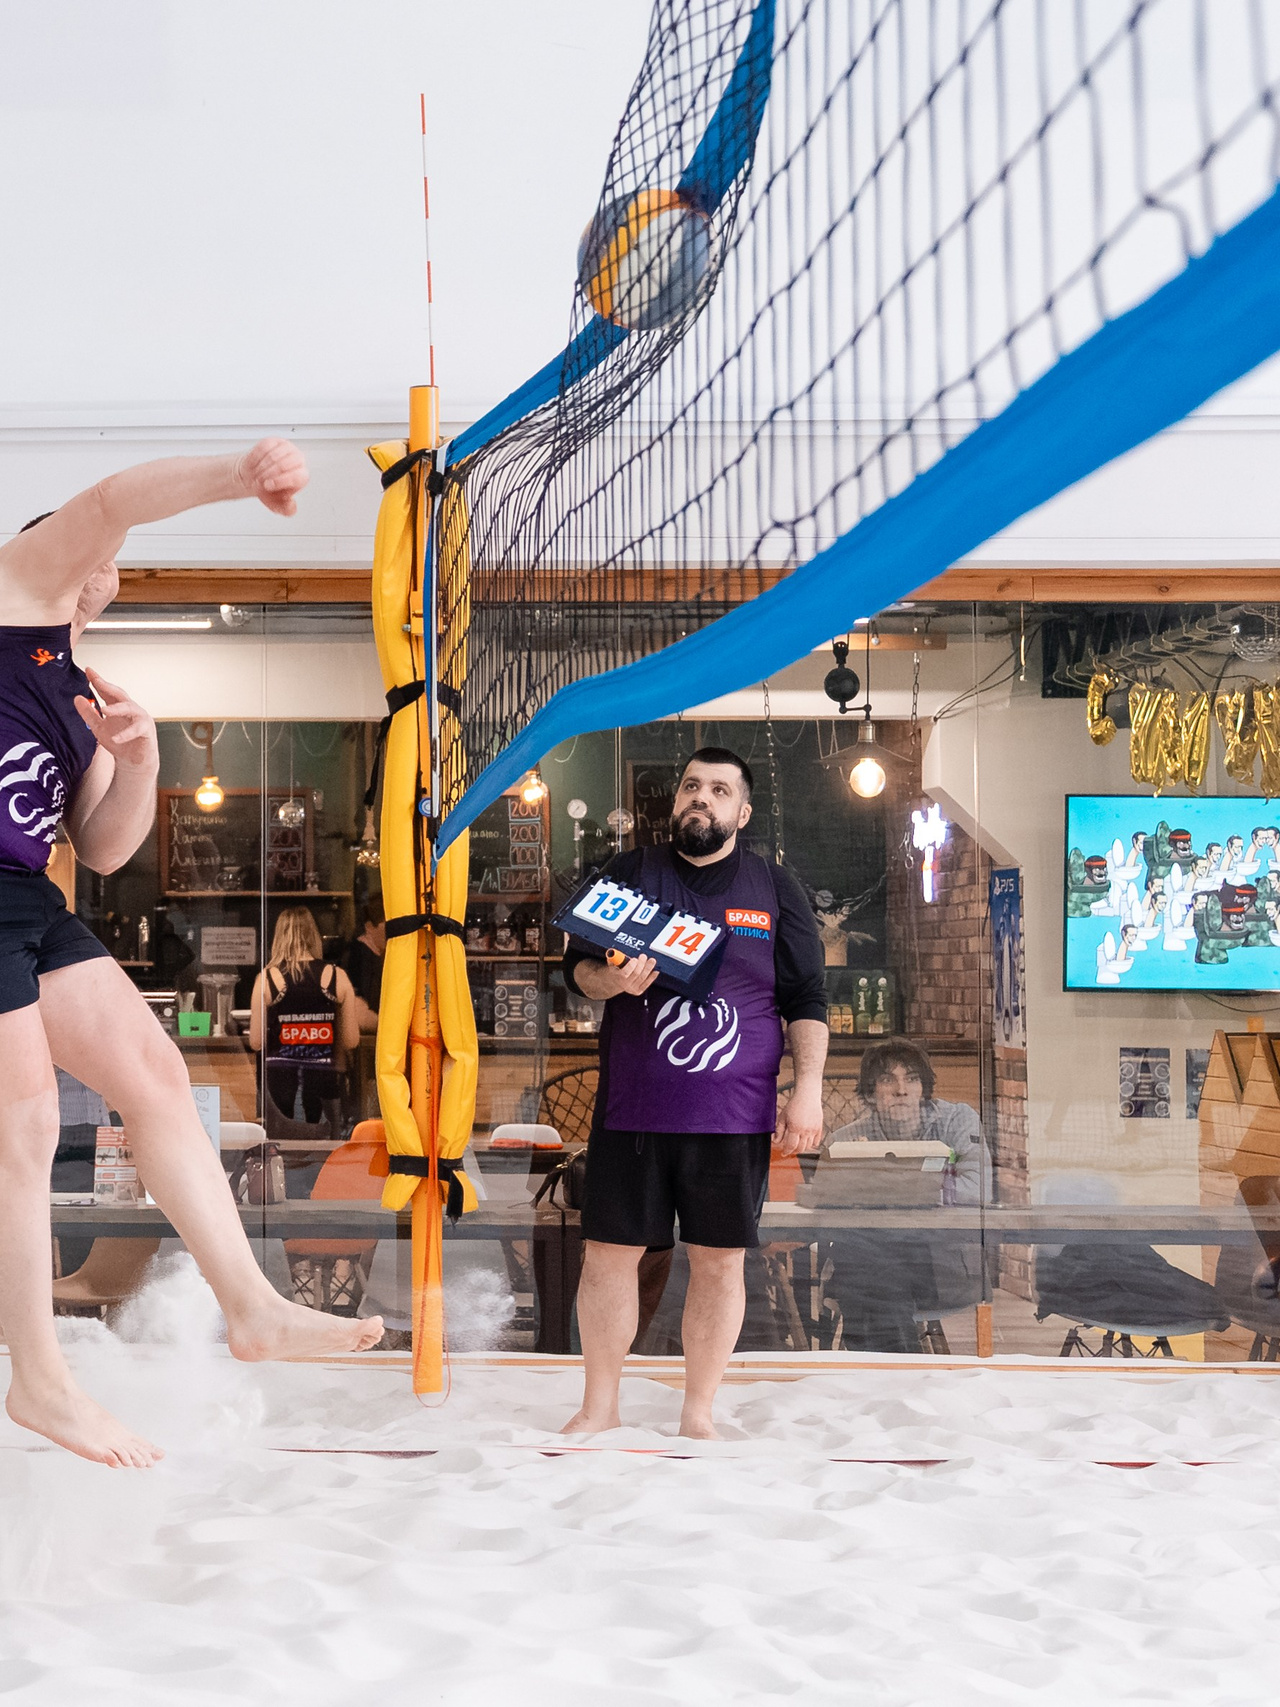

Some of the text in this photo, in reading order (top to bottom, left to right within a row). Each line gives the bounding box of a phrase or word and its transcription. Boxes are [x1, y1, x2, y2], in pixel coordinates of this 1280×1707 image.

[511, 824, 538, 842] 200
[588, 892, 628, 921] 13
[639, 907, 651, 919] 0
[664, 925, 705, 955] 14
[728, 912, 769, 926] БРАВО
[733, 926, 770, 940] ПТИКА
[281, 1027, 331, 1040] БРАВО
